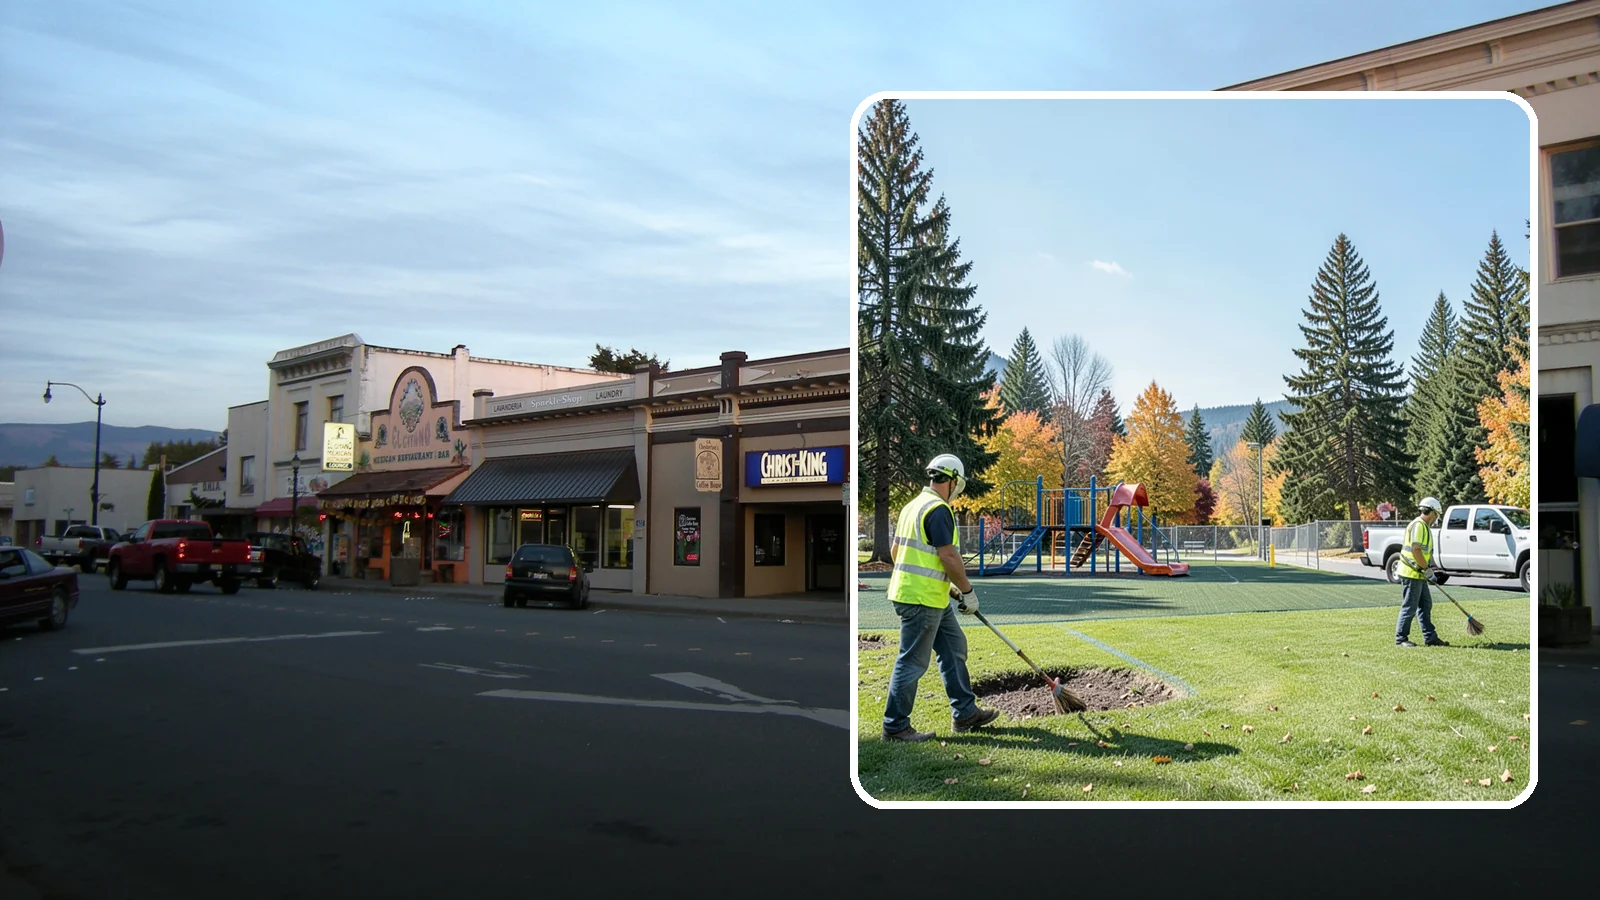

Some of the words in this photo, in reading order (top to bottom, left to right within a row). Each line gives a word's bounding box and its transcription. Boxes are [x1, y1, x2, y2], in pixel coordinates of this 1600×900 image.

[595, 389, 624, 400] LAUNDRY
[494, 402, 522, 412] LAVANDERIA
[373, 455, 396, 464] MEXICAN
[397, 451, 433, 462] RESTAURANT
[437, 450, 450, 459] BAR
